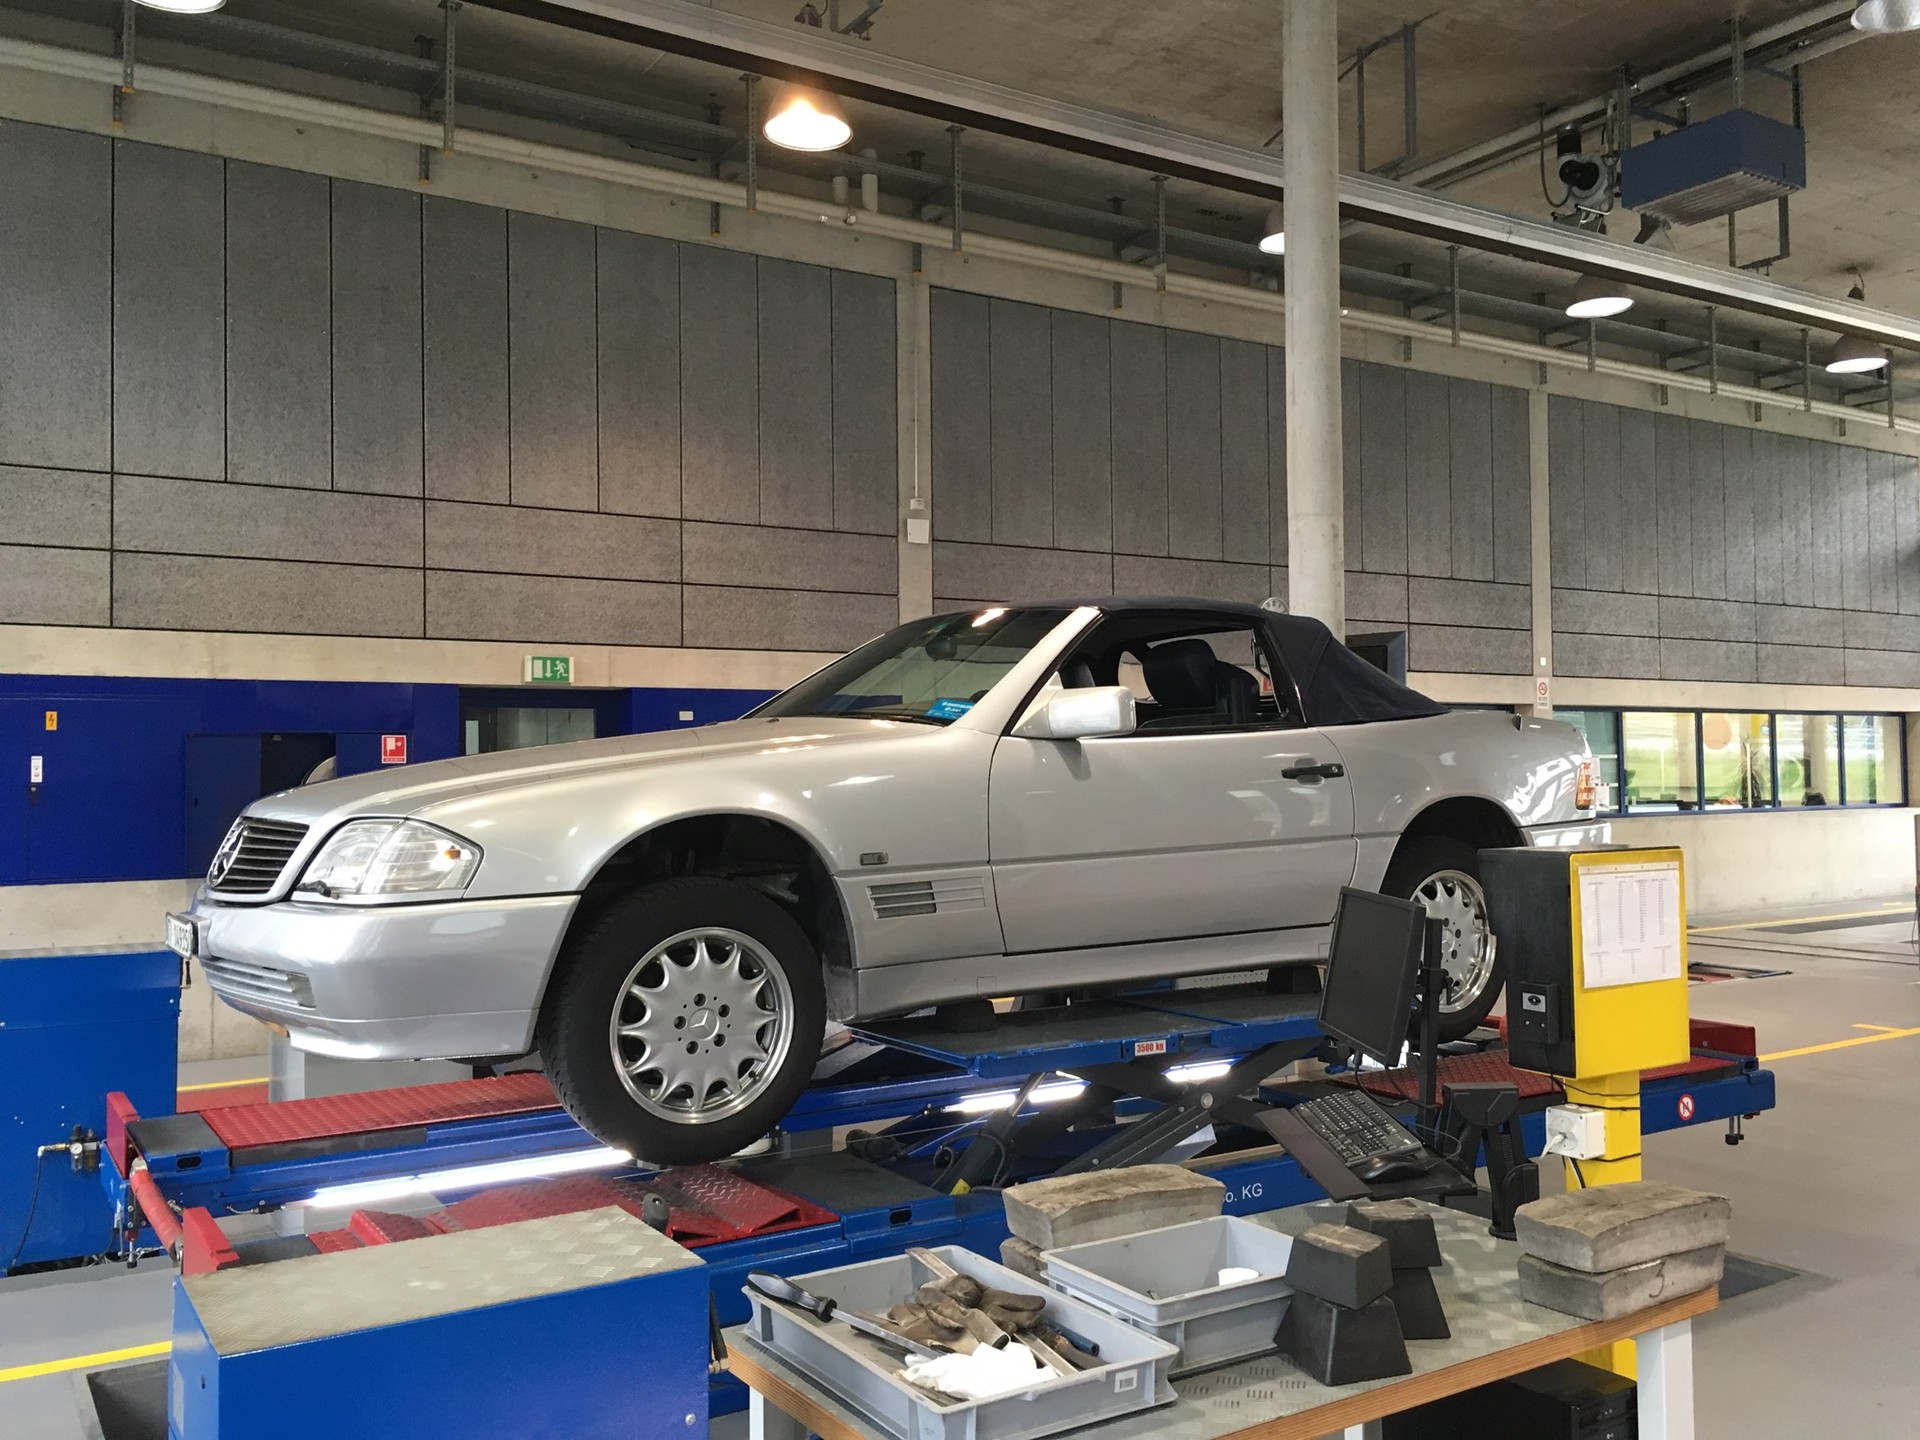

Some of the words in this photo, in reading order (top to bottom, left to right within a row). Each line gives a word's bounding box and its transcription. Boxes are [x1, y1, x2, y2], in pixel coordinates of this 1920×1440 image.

[1136, 1043, 1154, 1053] 3500
[1155, 1042, 1164, 1051] kg
[1223, 1192, 1237, 1203] o.
[1242, 1183, 1263, 1200] KG
